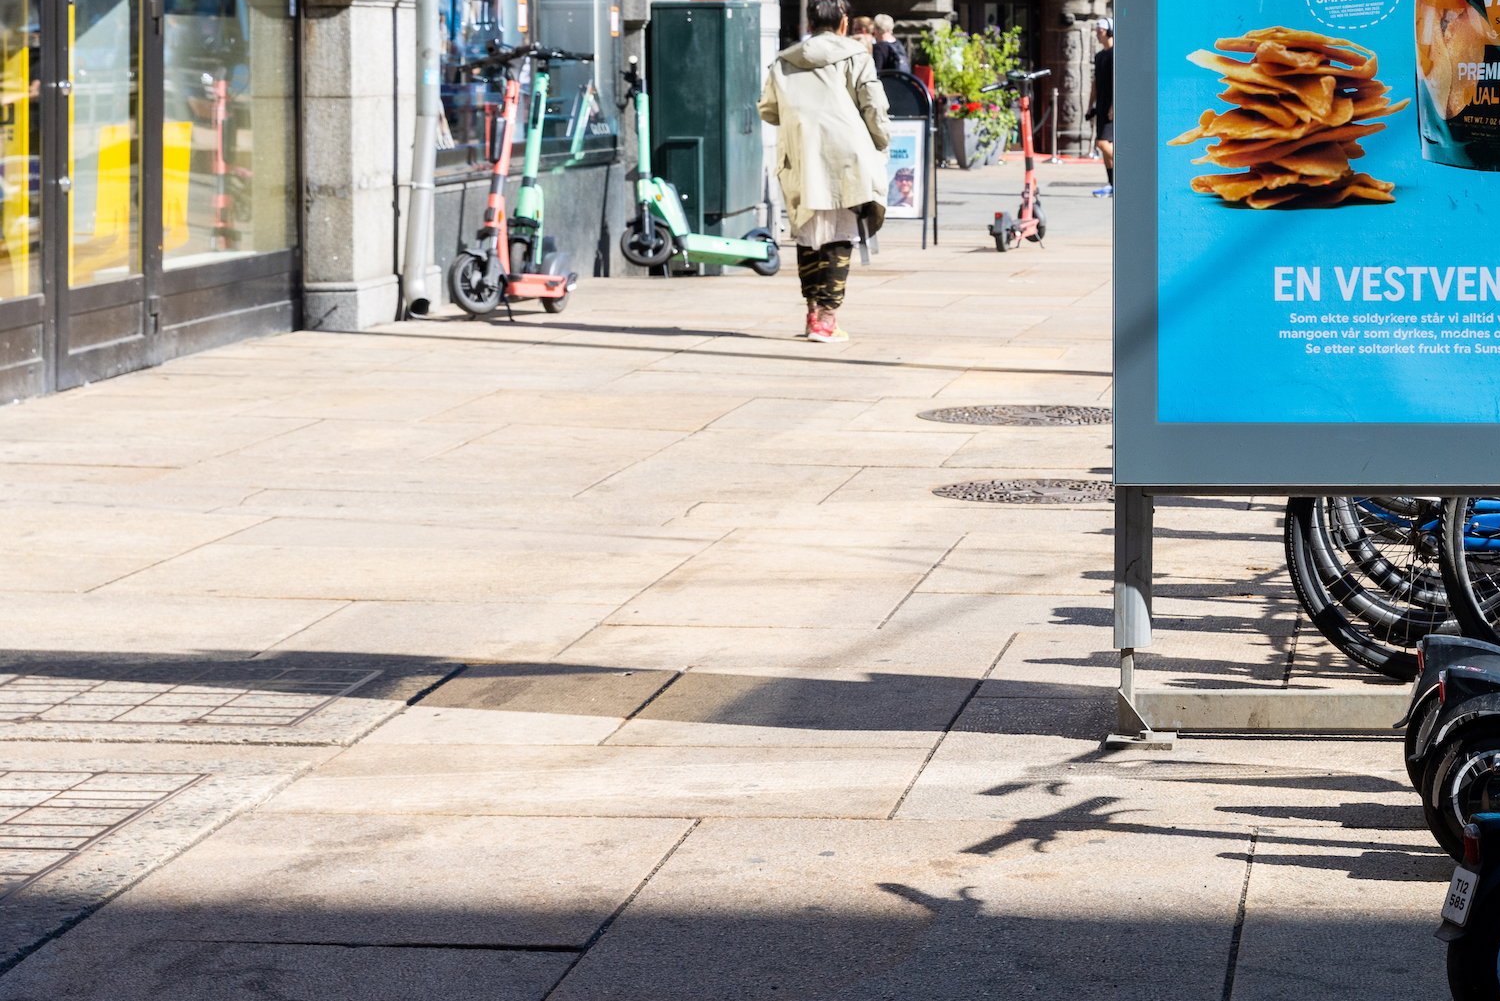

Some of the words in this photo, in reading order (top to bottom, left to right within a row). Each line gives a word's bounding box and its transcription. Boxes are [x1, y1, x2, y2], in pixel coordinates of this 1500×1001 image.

[1463, 115, 1473, 123] NET
[1274, 266, 1321, 301] EN
[1290, 313, 1317, 323] Som
[1321, 313, 1349, 323] ekte
[1352, 313, 1417, 326] soldyrkere
[1421, 312, 1445, 323] står
[1448, 313, 1458, 323] vi
[1462, 312, 1494, 323] alltid
[1279, 330, 1337, 341] mangoen
[1341, 327, 1360, 338] vår
[1364, 330, 1389, 338] som
[1393, 328, 1437, 340] dyrkes,
[1441, 328, 1490, 338] modnes
[1305, 343, 1320, 353] Se
[1324, 344, 1355, 353] etter
[1358, 343, 1415, 353] soltørket
[1418, 343, 1450, 353] frukt
[1453, 343, 1471, 353] fra
[1456, 878, 1469, 895] TI2
[1449, 893, 1466, 912] 585
